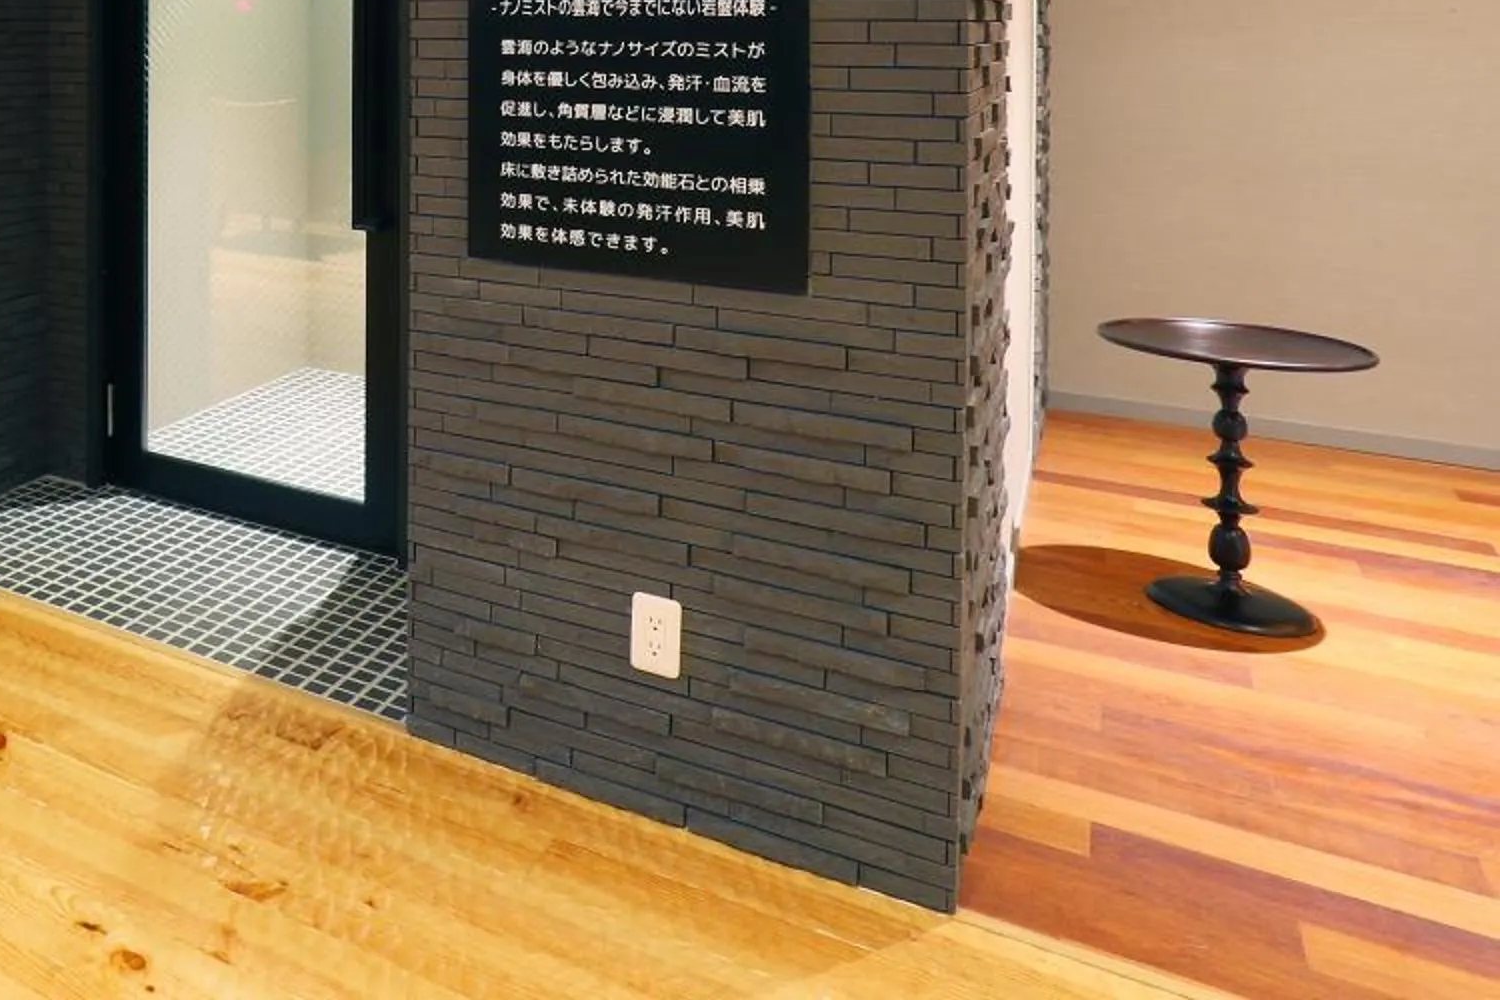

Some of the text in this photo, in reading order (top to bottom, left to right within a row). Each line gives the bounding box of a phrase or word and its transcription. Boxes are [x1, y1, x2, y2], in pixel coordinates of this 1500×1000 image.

[500, 131, 651, 155] 効果をもたらします。
[500, 223, 669, 255] 効果を体感できます。
